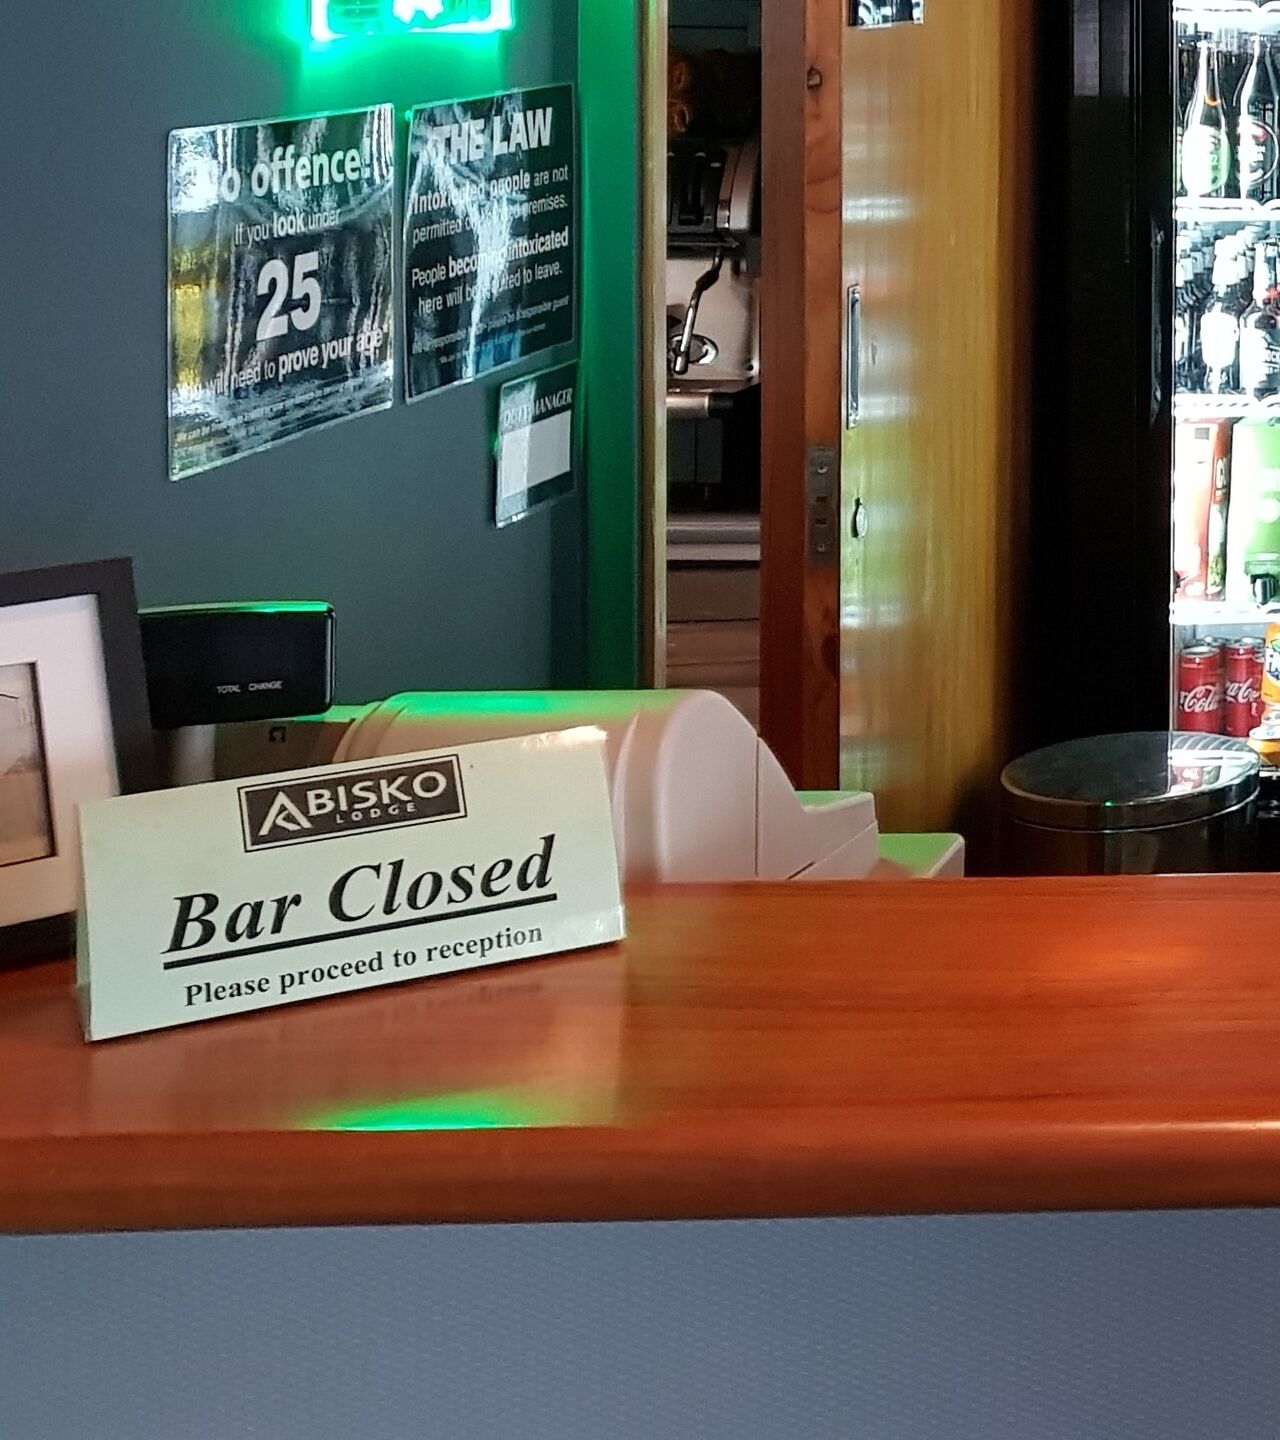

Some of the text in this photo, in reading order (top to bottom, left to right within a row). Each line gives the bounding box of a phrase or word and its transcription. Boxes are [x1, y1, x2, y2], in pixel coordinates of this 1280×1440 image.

[433, 107, 553, 165] THE LAW
[490, 169, 531, 198] people
[534, 170, 549, 186] are
[552, 164, 568, 182] not
[235, 208, 340, 248] If you look under
[413, 217, 461, 249] permitted
[412, 262, 446, 288] People
[508, 225, 569, 261] intoxicated
[256, 250, 322, 341] 25
[418, 294, 443, 317] here
[446, 286, 463, 307] will
[523, 268, 532, 285] to
[535, 261, 562, 281] leave.
[231, 363, 261, 388] need
[264, 362, 275, 379] to
[279, 345, 319, 382] prove
[322, 332, 354, 369] your
[216, 680, 283, 694] TOTAL CHANGE
[257, 770, 448, 836] ABISKO
[336, 801, 417, 825] LODGE
[160, 833, 556, 956] Bar Closed
[184, 925, 543, 1007] Please proceed to reception
